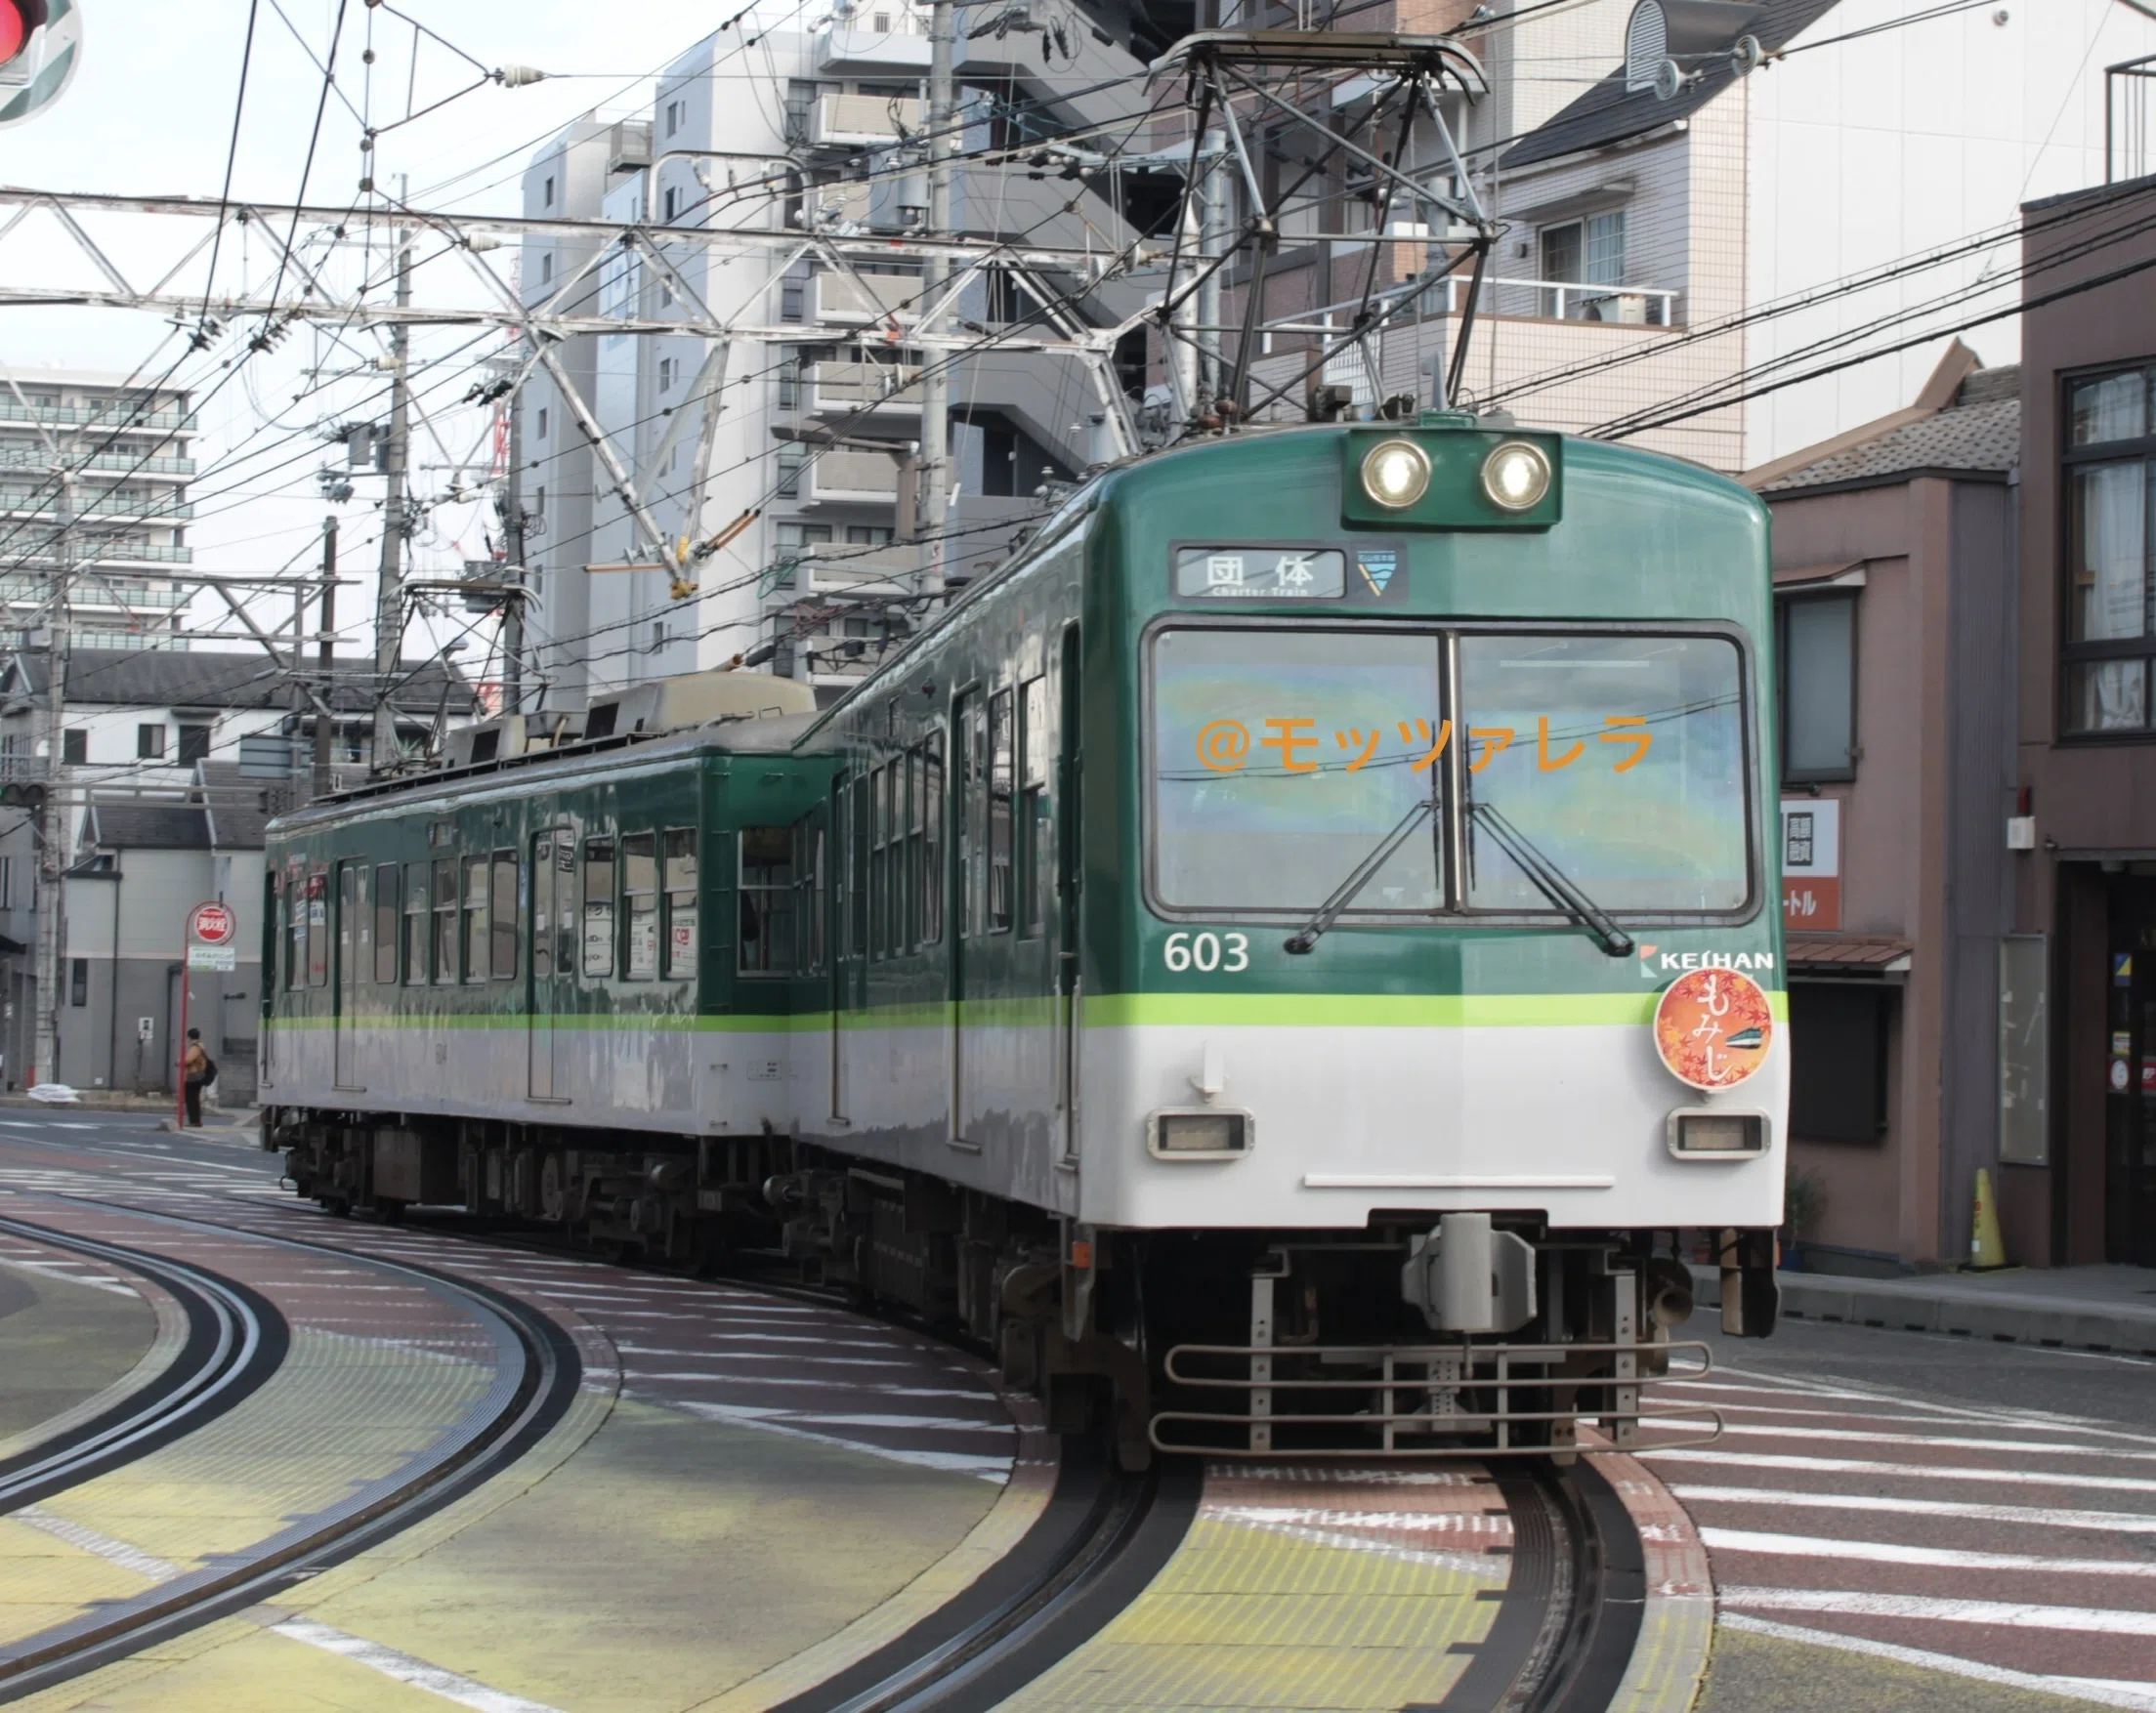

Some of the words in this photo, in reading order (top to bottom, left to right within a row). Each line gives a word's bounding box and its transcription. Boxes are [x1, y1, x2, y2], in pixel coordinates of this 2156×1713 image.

[1206, 556, 1314, 586] 団体
[1212, 586, 1267, 597] Charter
[1271, 586, 1309, 597] Train
[1164, 932, 1249, 972] 603
[1661, 950, 1775, 970] KEIHAN
[1692, 974, 1732, 1081] もみじ
